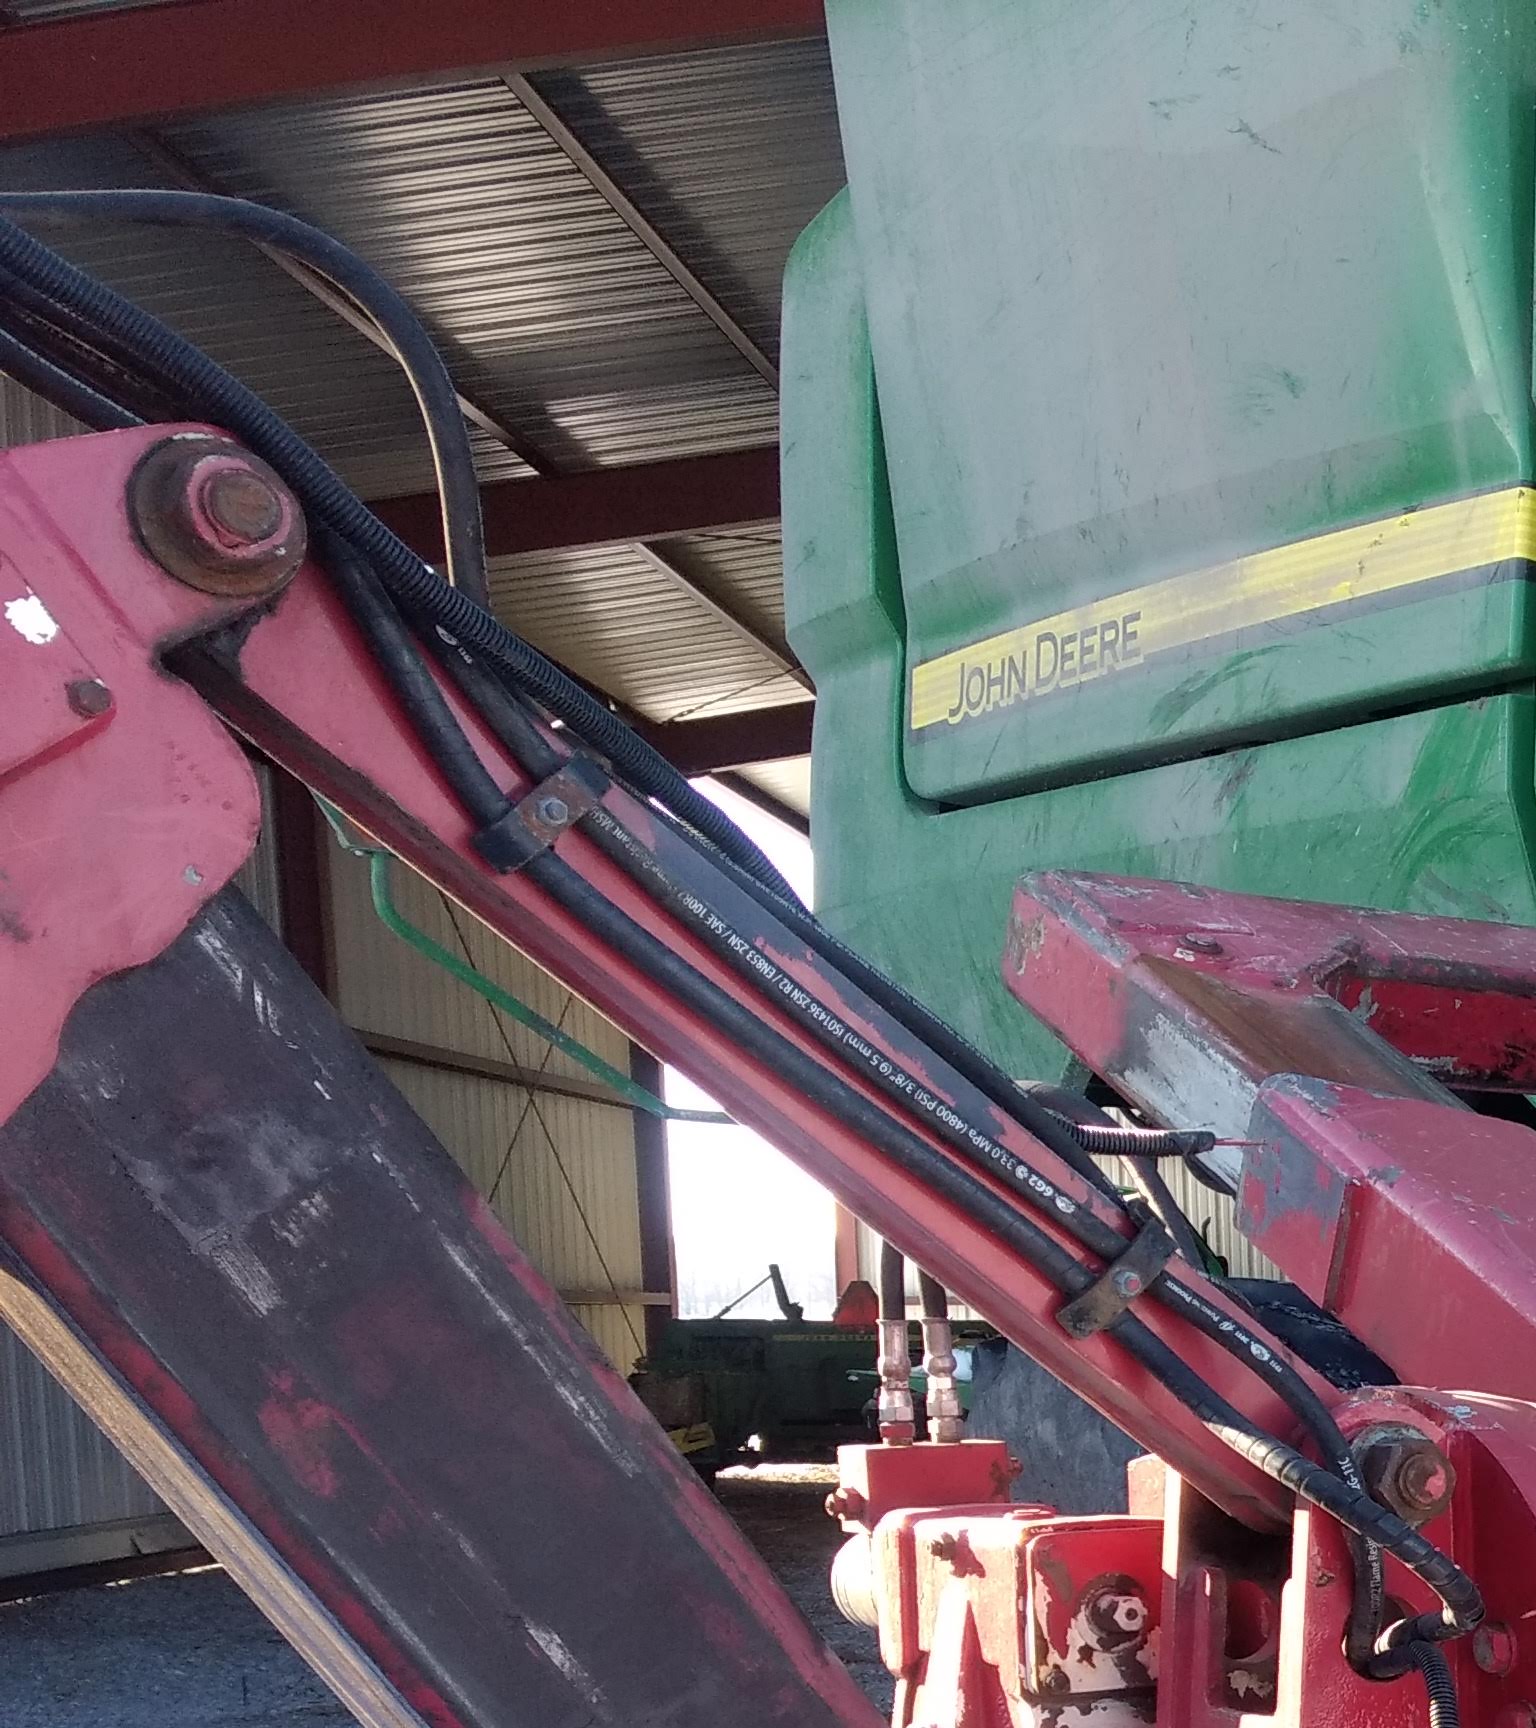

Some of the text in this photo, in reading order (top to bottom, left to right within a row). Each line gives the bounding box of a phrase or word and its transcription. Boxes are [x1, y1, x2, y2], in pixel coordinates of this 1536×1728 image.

[947, 610, 1143, 722] JOHN DEERE
[704, 913, 726, 934] SAE
[727, 933, 749, 954] 2SN
[745, 949, 776, 978] EN853
[778, 977, 793, 993] R2
[790, 988, 811, 1008] 2SN
[934, 1105, 968, 1133] (4800
[965, 1128, 992, 1151] MPa
[1026, 1173, 1055, 1197] 6G2
